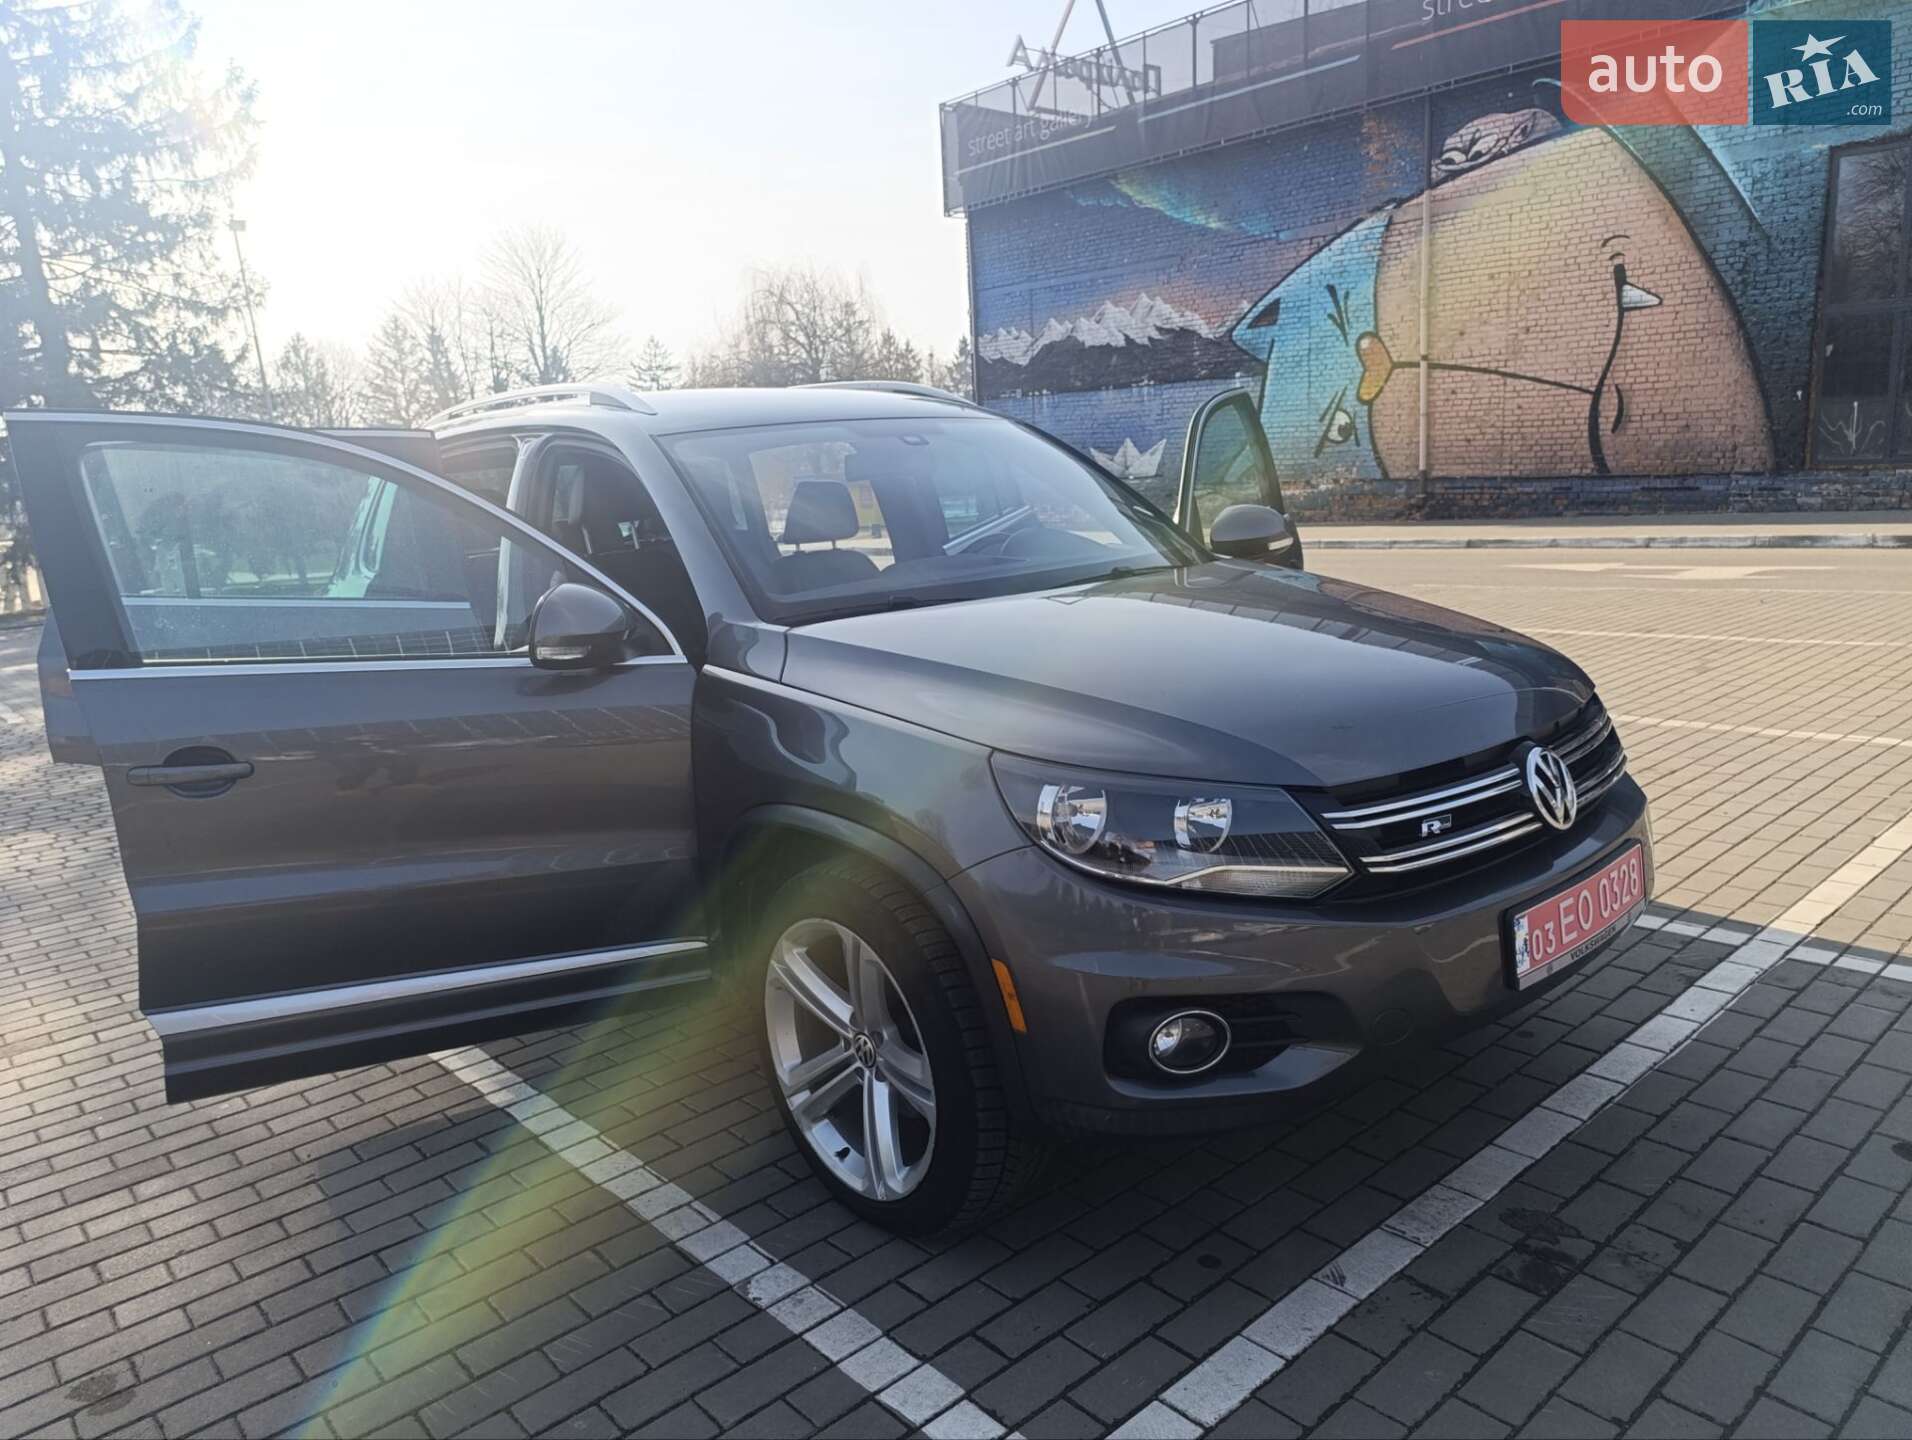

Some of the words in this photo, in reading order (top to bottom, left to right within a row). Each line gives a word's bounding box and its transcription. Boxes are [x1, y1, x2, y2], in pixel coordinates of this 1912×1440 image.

[967, 127, 1011, 157] street
[1015, 119, 1037, 142] art
[1040, 110, 1093, 141] gallery
[1532, 920, 1556, 961] 03
[1558, 889, 1593, 945] EO
[1599, 858, 1638, 919] 0328
